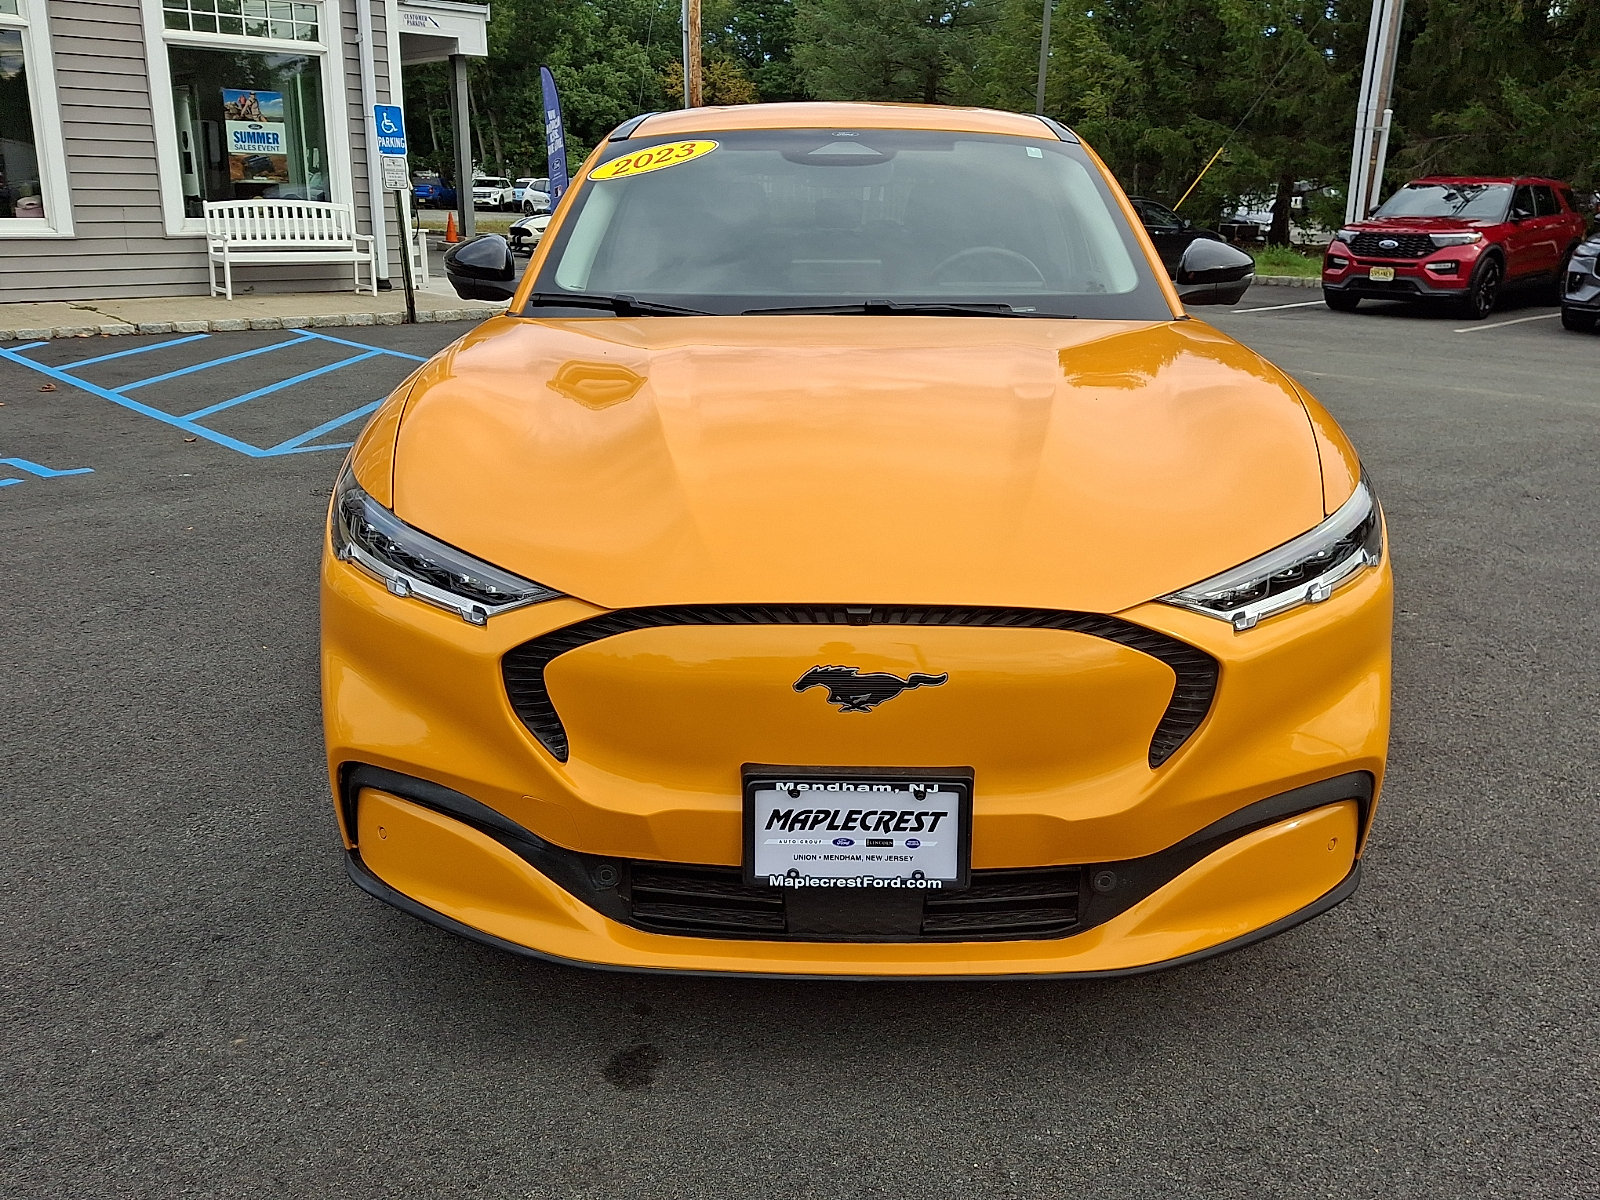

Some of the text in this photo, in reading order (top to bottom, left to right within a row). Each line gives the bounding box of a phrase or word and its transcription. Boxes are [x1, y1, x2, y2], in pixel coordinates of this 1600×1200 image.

[233, 131, 279, 144] SUMMER
[378, 137, 405, 148] PARKING
[611, 143, 696, 176] 2023
[776, 783, 939, 794] Mendham, NJ
[764, 809, 949, 834] MAPLECREST
[769, 875, 942, 889] MaplecrestFord.com
